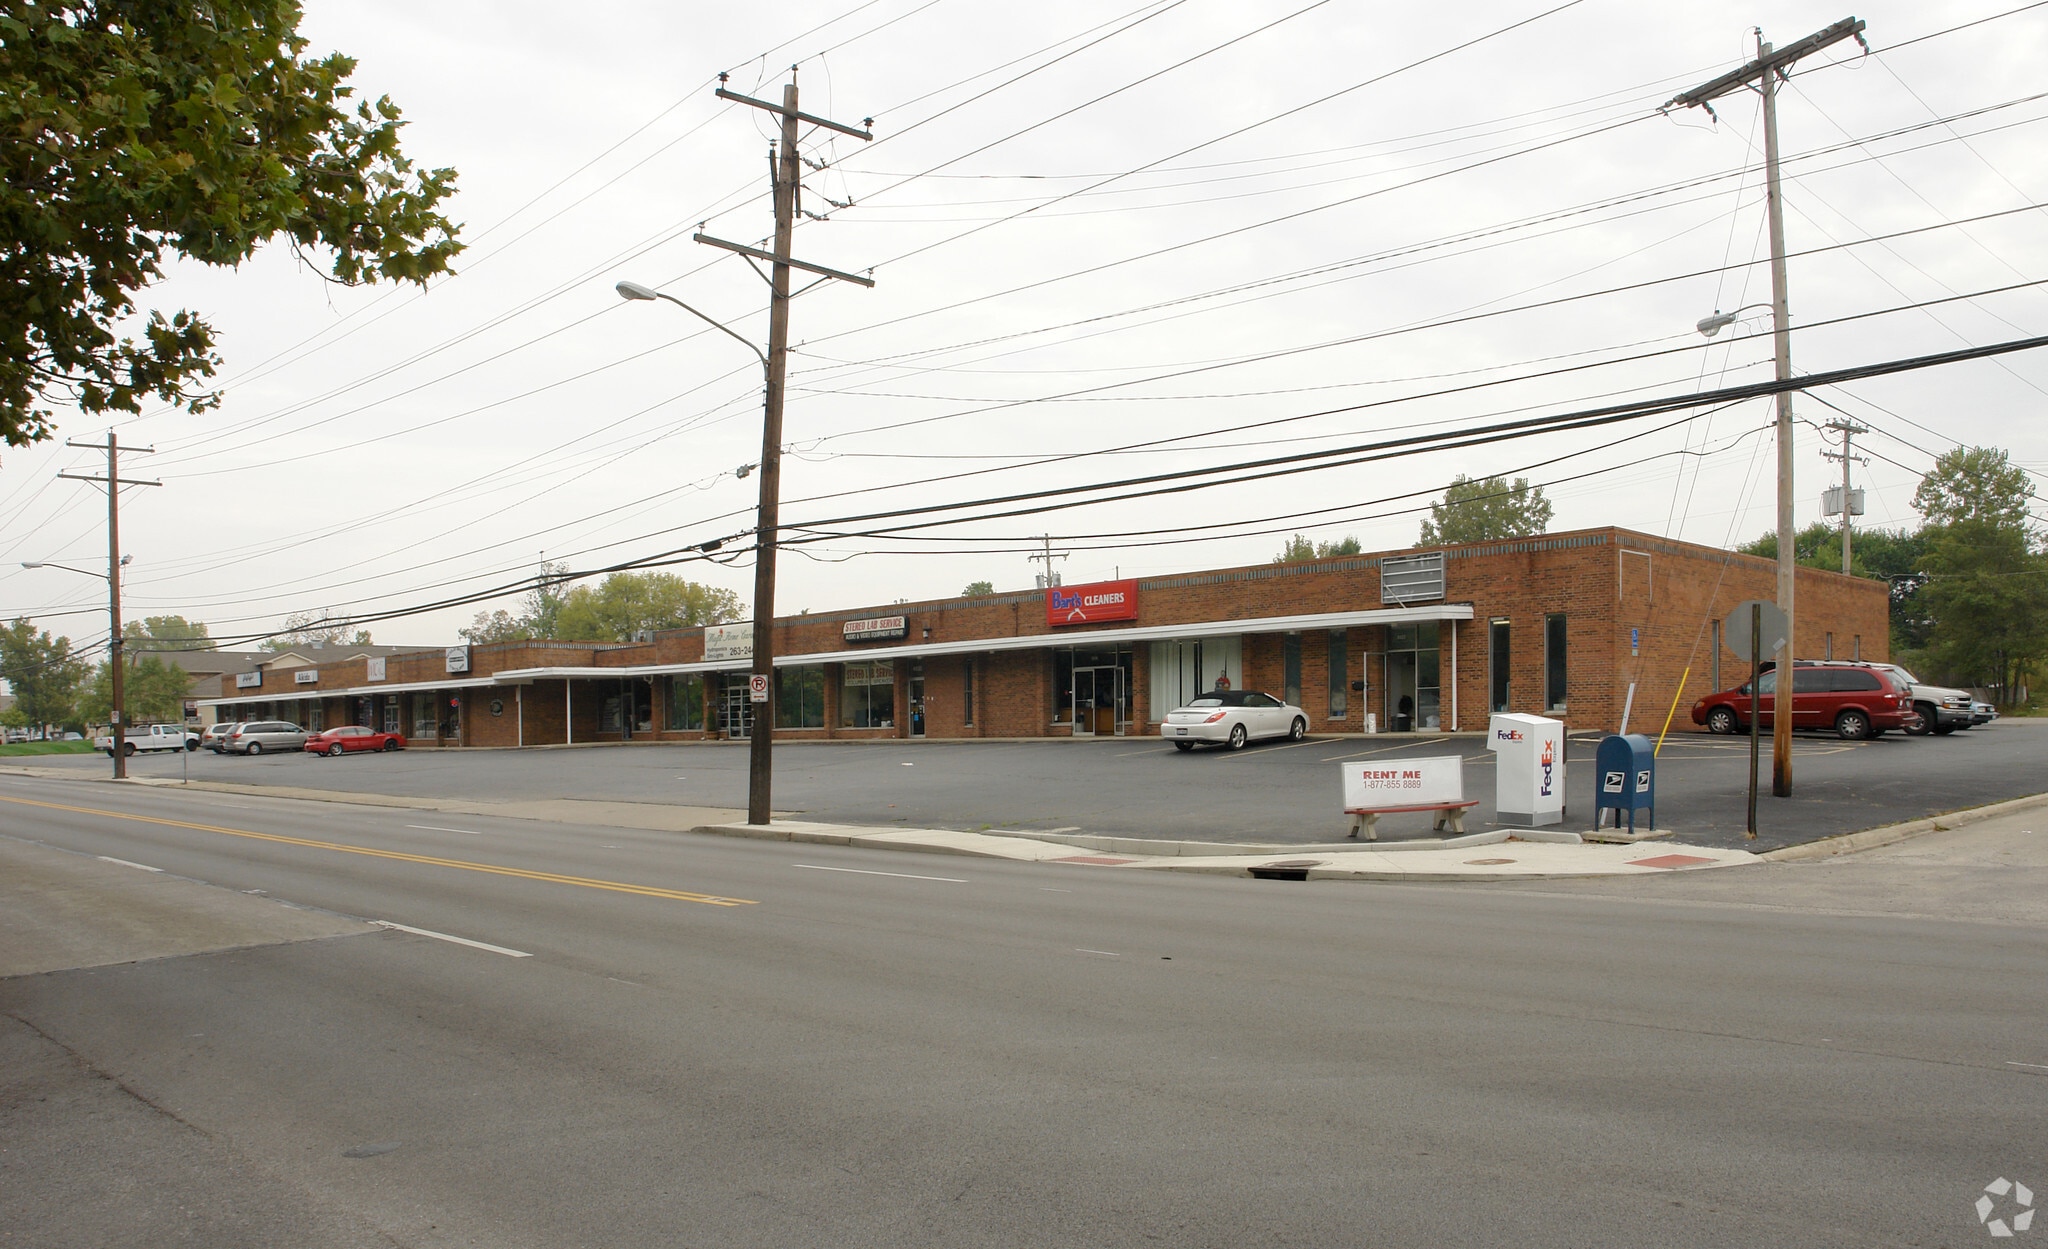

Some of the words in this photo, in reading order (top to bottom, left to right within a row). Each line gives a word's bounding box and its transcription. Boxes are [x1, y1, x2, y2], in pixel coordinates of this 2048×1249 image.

[1052, 591, 1082, 610] Bart's
[1084, 593, 1125, 606] CLEANERS
[845, 621, 866, 632] STEREO
[867, 620, 878, 630] LAB
[880, 618, 903, 629] SERVICE
[846, 668, 865, 680] STEREO
[1497, 730, 1523, 740] FedEx
[1541, 739, 1552, 797] FedEx
[1363, 771, 1398, 779] RENT
[1402, 770, 1421, 779] ME
[1363, 780, 1401, 789] 1-877-855
[1402, 780, 1421, 789] 8889
